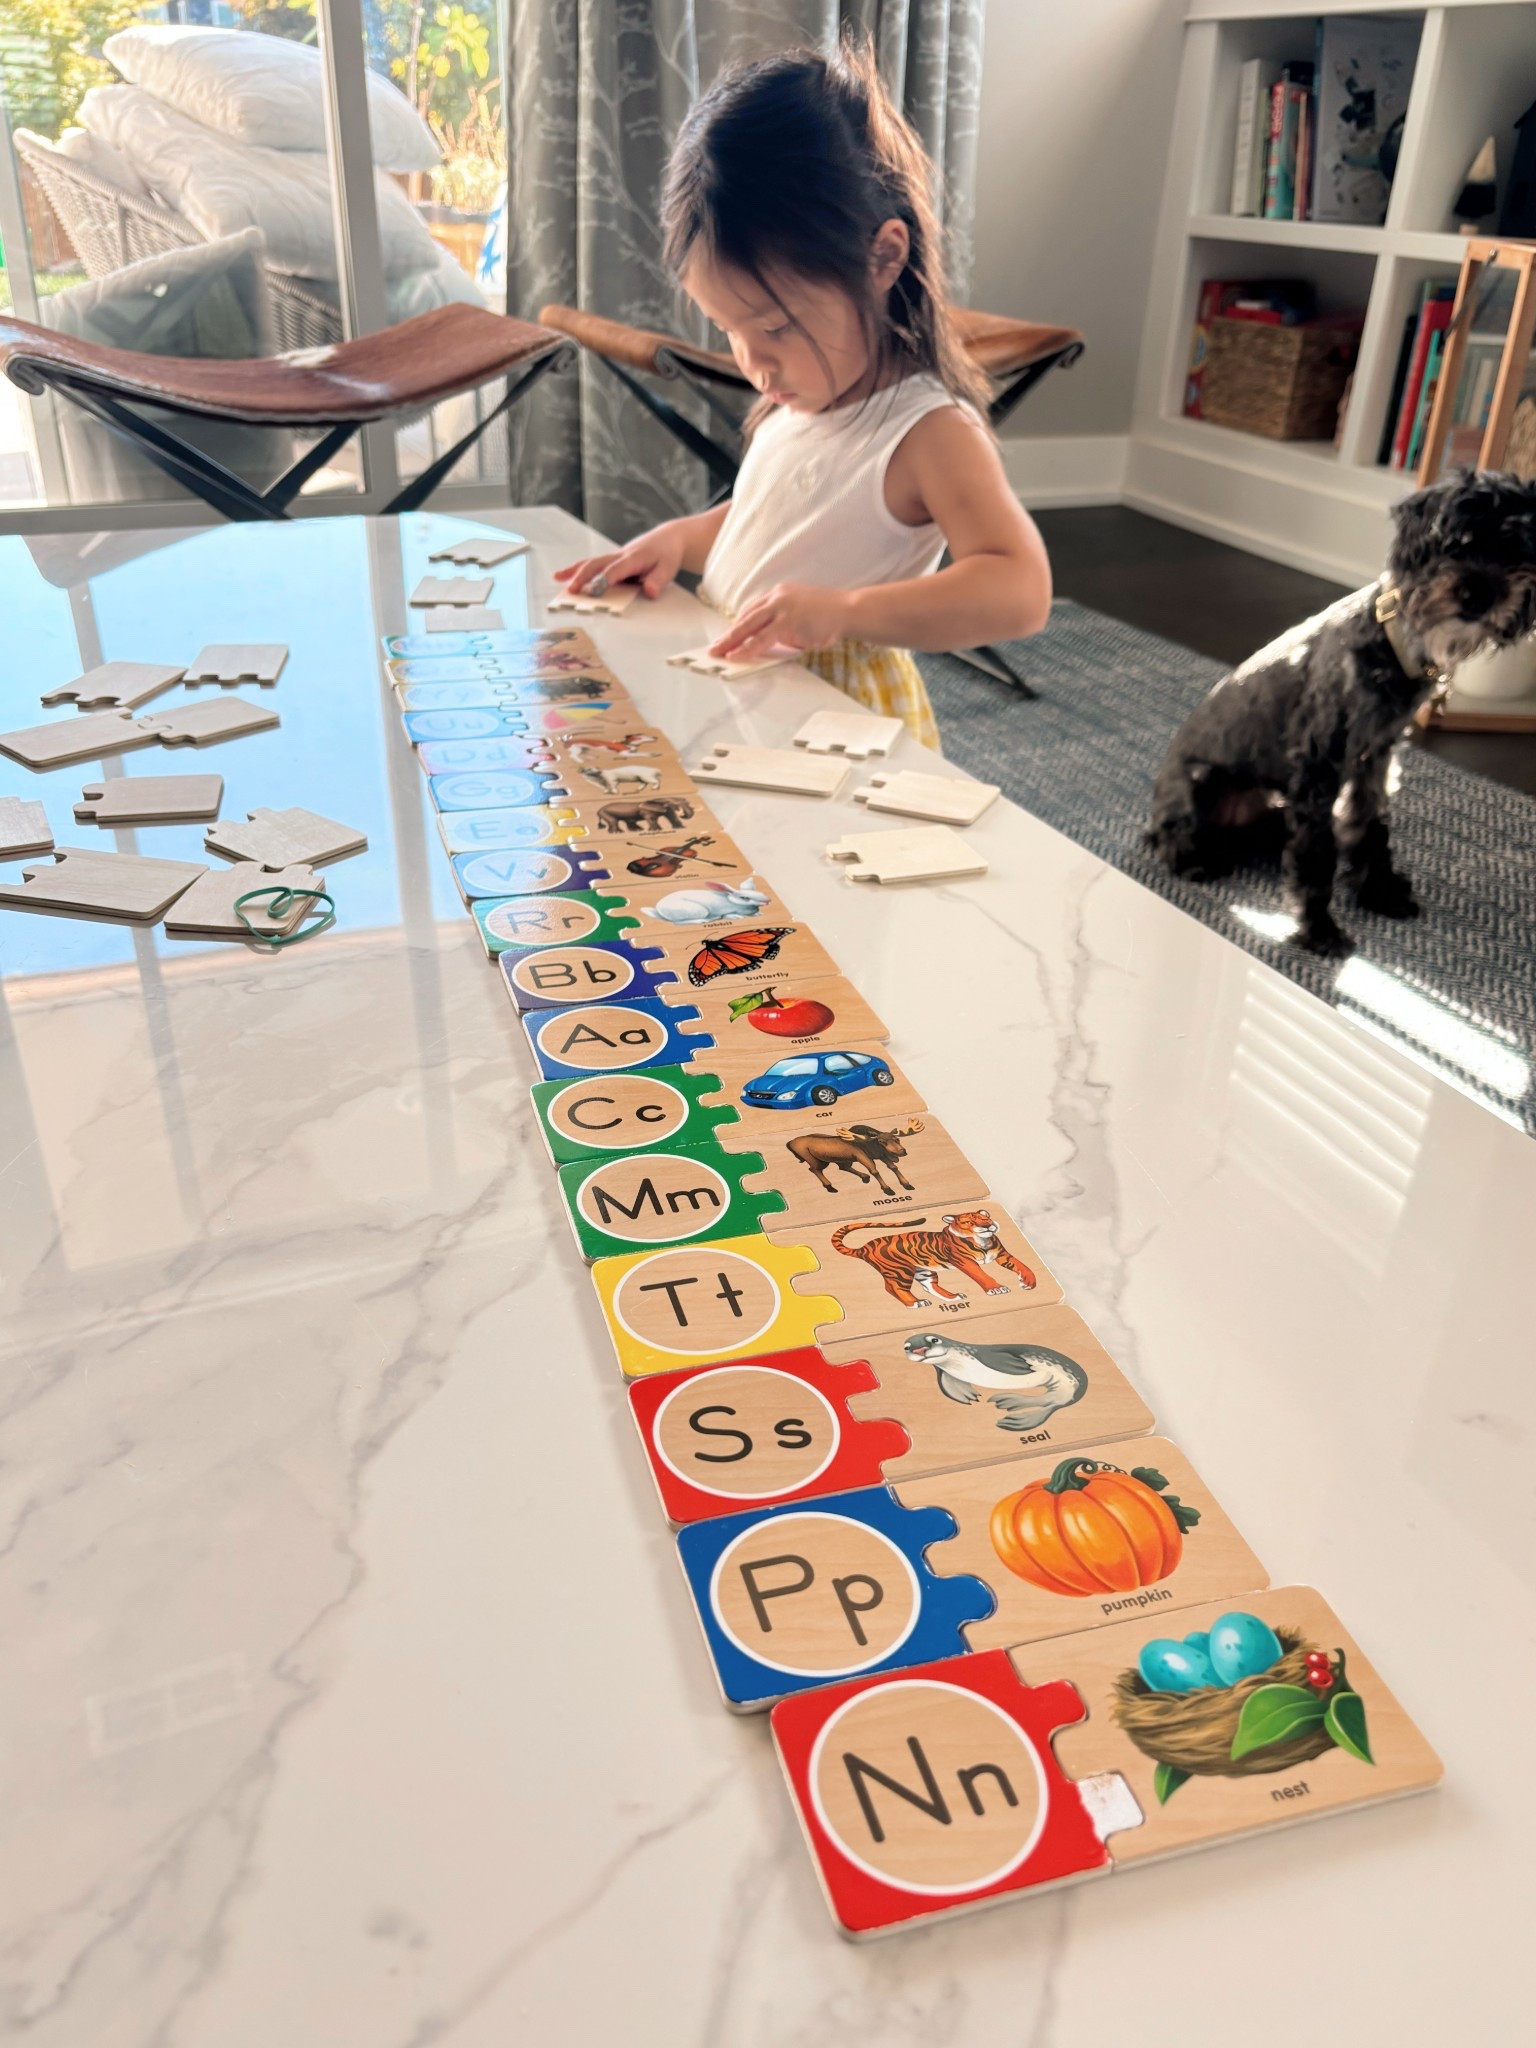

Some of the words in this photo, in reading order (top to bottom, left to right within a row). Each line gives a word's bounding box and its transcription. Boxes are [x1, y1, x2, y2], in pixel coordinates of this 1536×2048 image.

[441, 746, 508, 764] Dd
[451, 781, 520, 799] Gg
[484, 862, 549, 882] Vv
[506, 910, 585, 934] Rr
[528, 960, 617, 990] Bb
[745, 971, 790, 982] butterfly
[560, 1023, 651, 1054] Aa
[790, 1035, 821, 1045] apple
[567, 1096, 667, 1130] Cc
[815, 1110, 834, 1119] car
[592, 1178, 721, 1224] Mm
[872, 1195, 913, 1207] moose
[639, 1272, 744, 1327] Tt
[938, 1300, 972, 1313] tiger
[689, 1405, 812, 1463] Ss
[1019, 1429, 1052, 1446] seal
[739, 1554, 884, 1647] Pp
[1101, 1586, 1174, 1617] pumpkin
[842, 1736, 1020, 1843] Nn
[1270, 1780, 1312, 1802] nest
